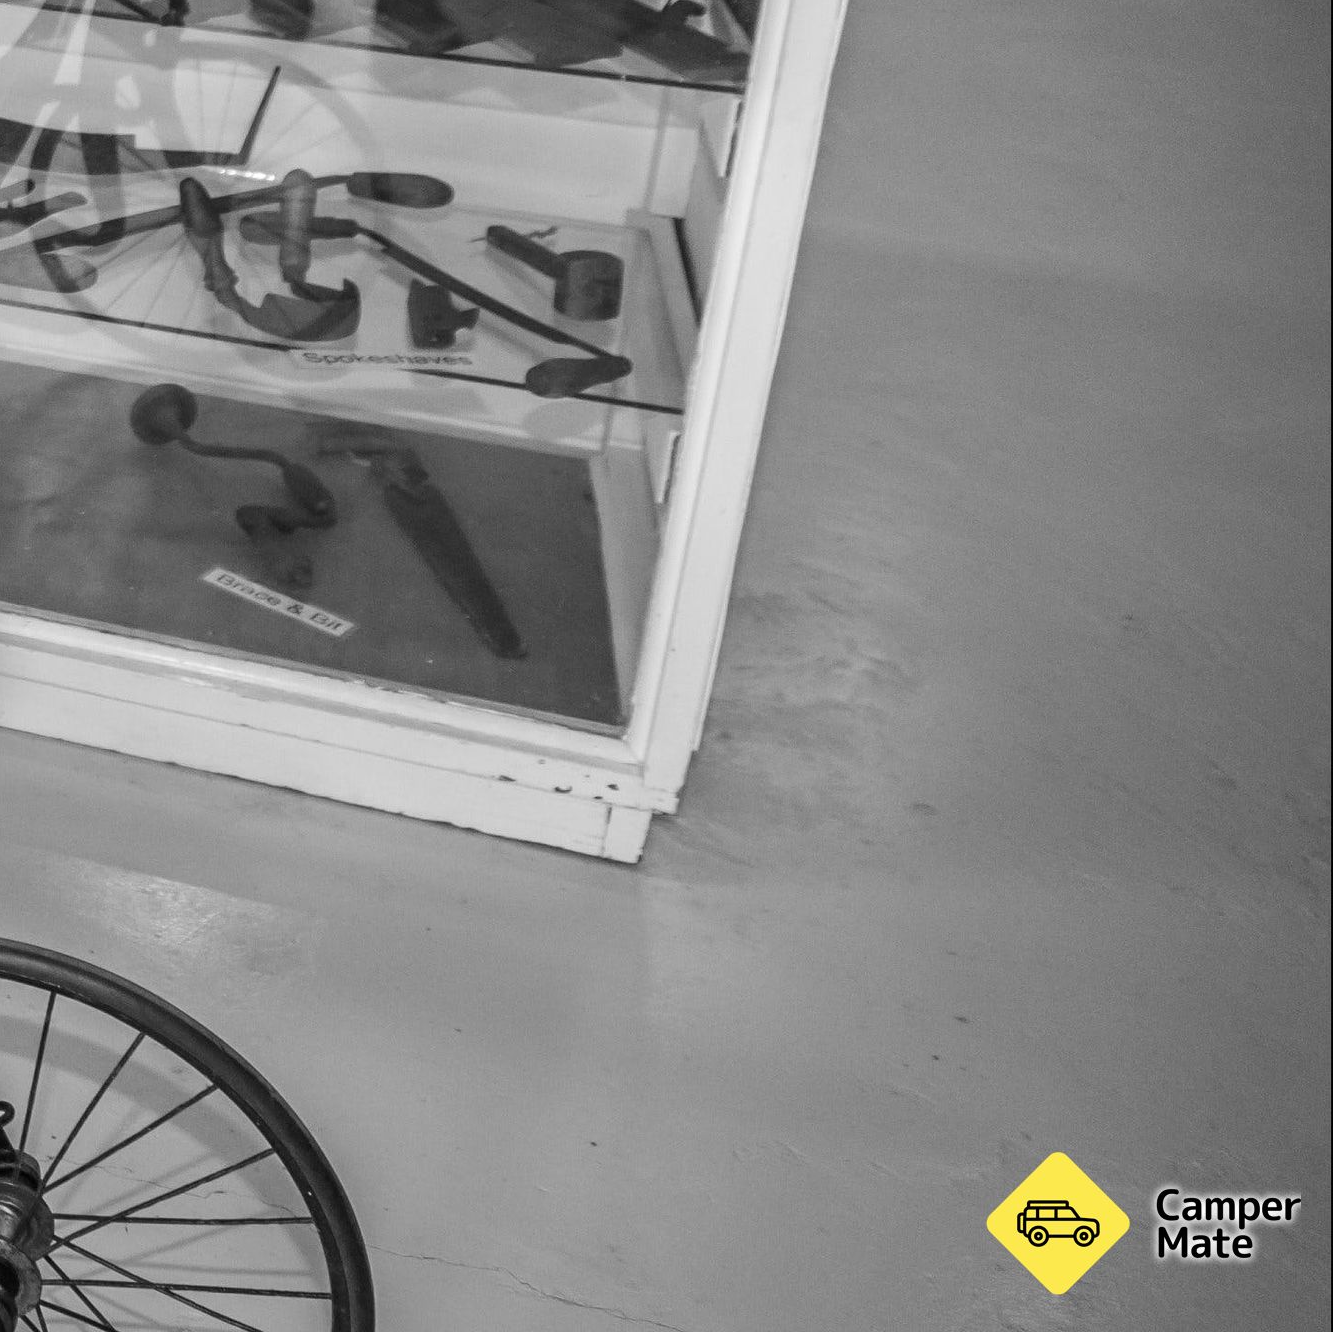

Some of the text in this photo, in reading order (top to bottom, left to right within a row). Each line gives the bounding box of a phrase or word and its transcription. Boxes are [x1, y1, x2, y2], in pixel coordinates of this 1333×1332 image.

[216, 573, 344, 631] Brace & Bit
